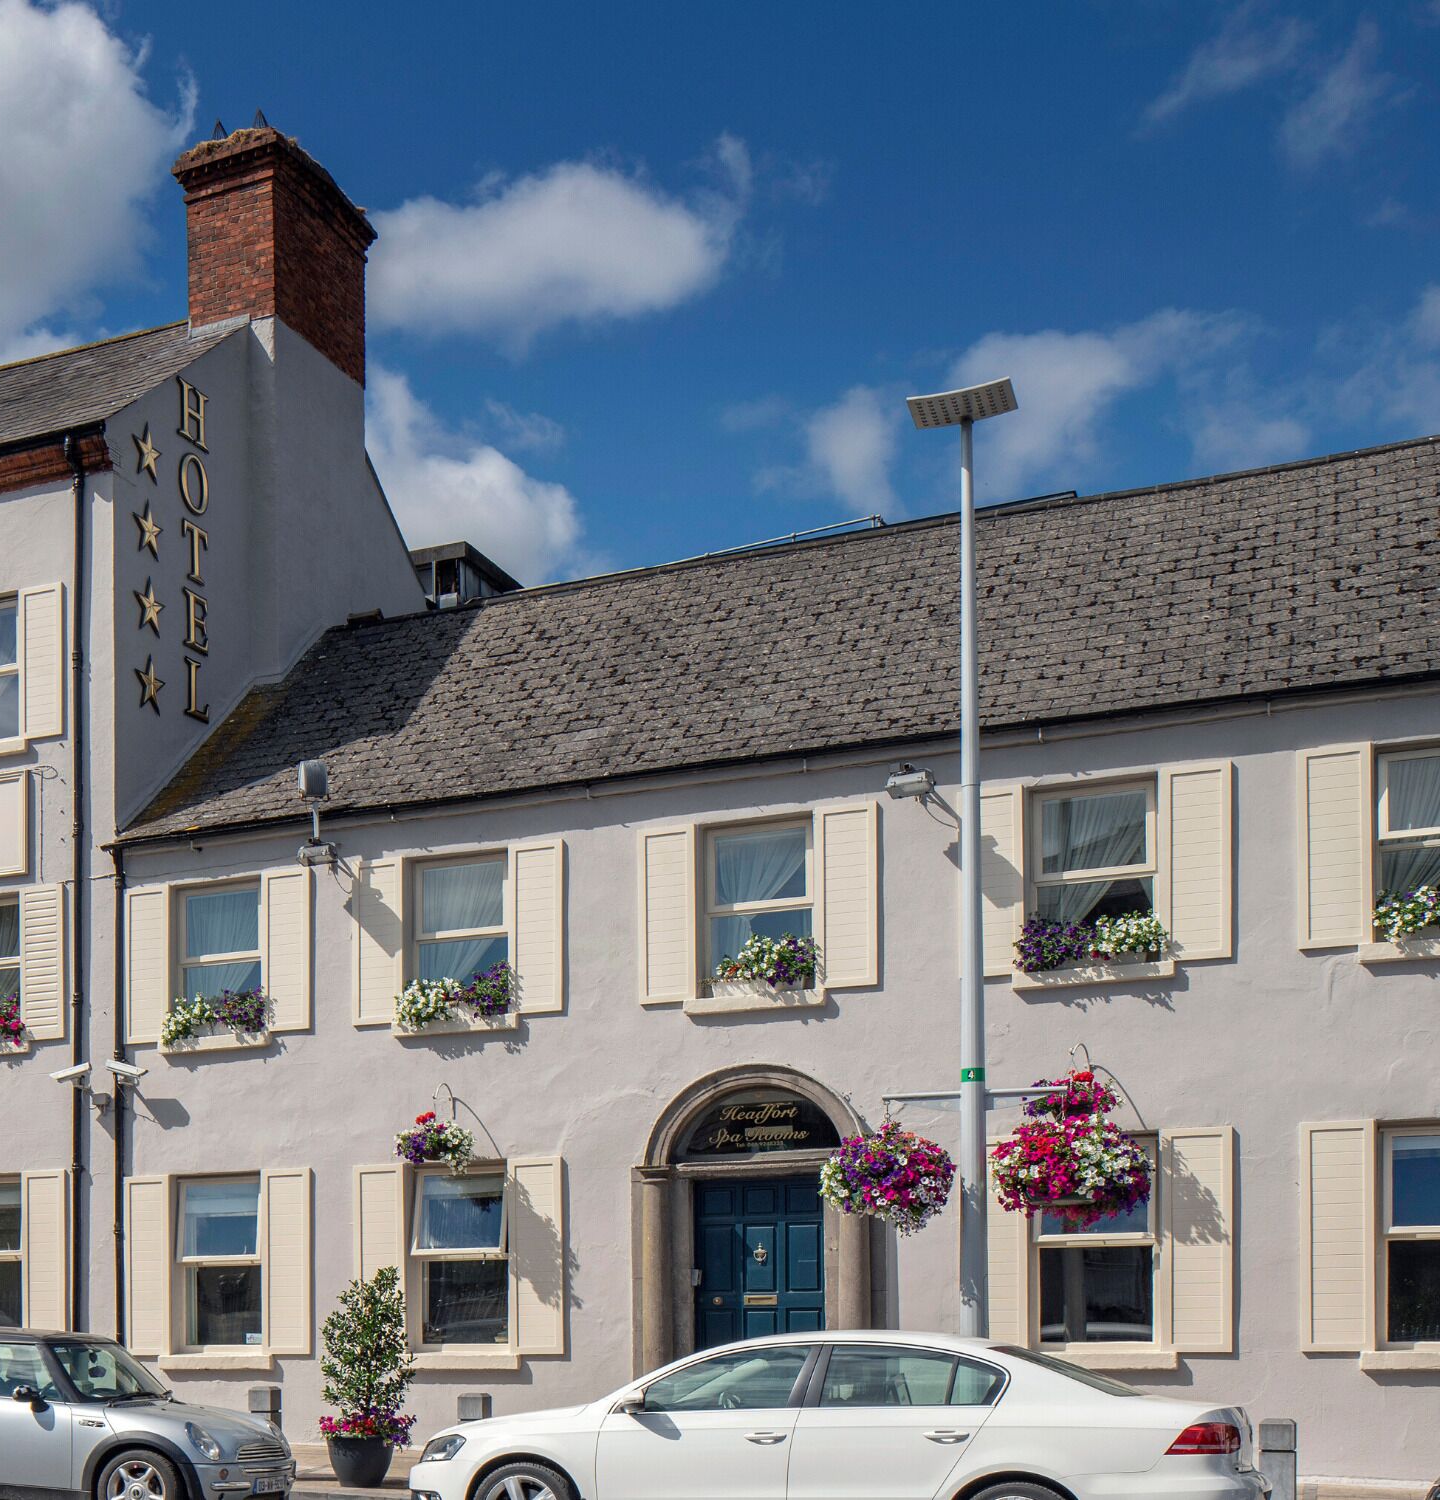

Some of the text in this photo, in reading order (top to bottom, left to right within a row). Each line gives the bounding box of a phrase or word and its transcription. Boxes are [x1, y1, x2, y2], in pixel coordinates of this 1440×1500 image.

[177, 375, 209, 723] HOTEL
[967, 1069, 975, 1080] 4
[720, 1103, 799, 1124] Headfort
[709, 1125, 809, 1148] Spa Rooms
